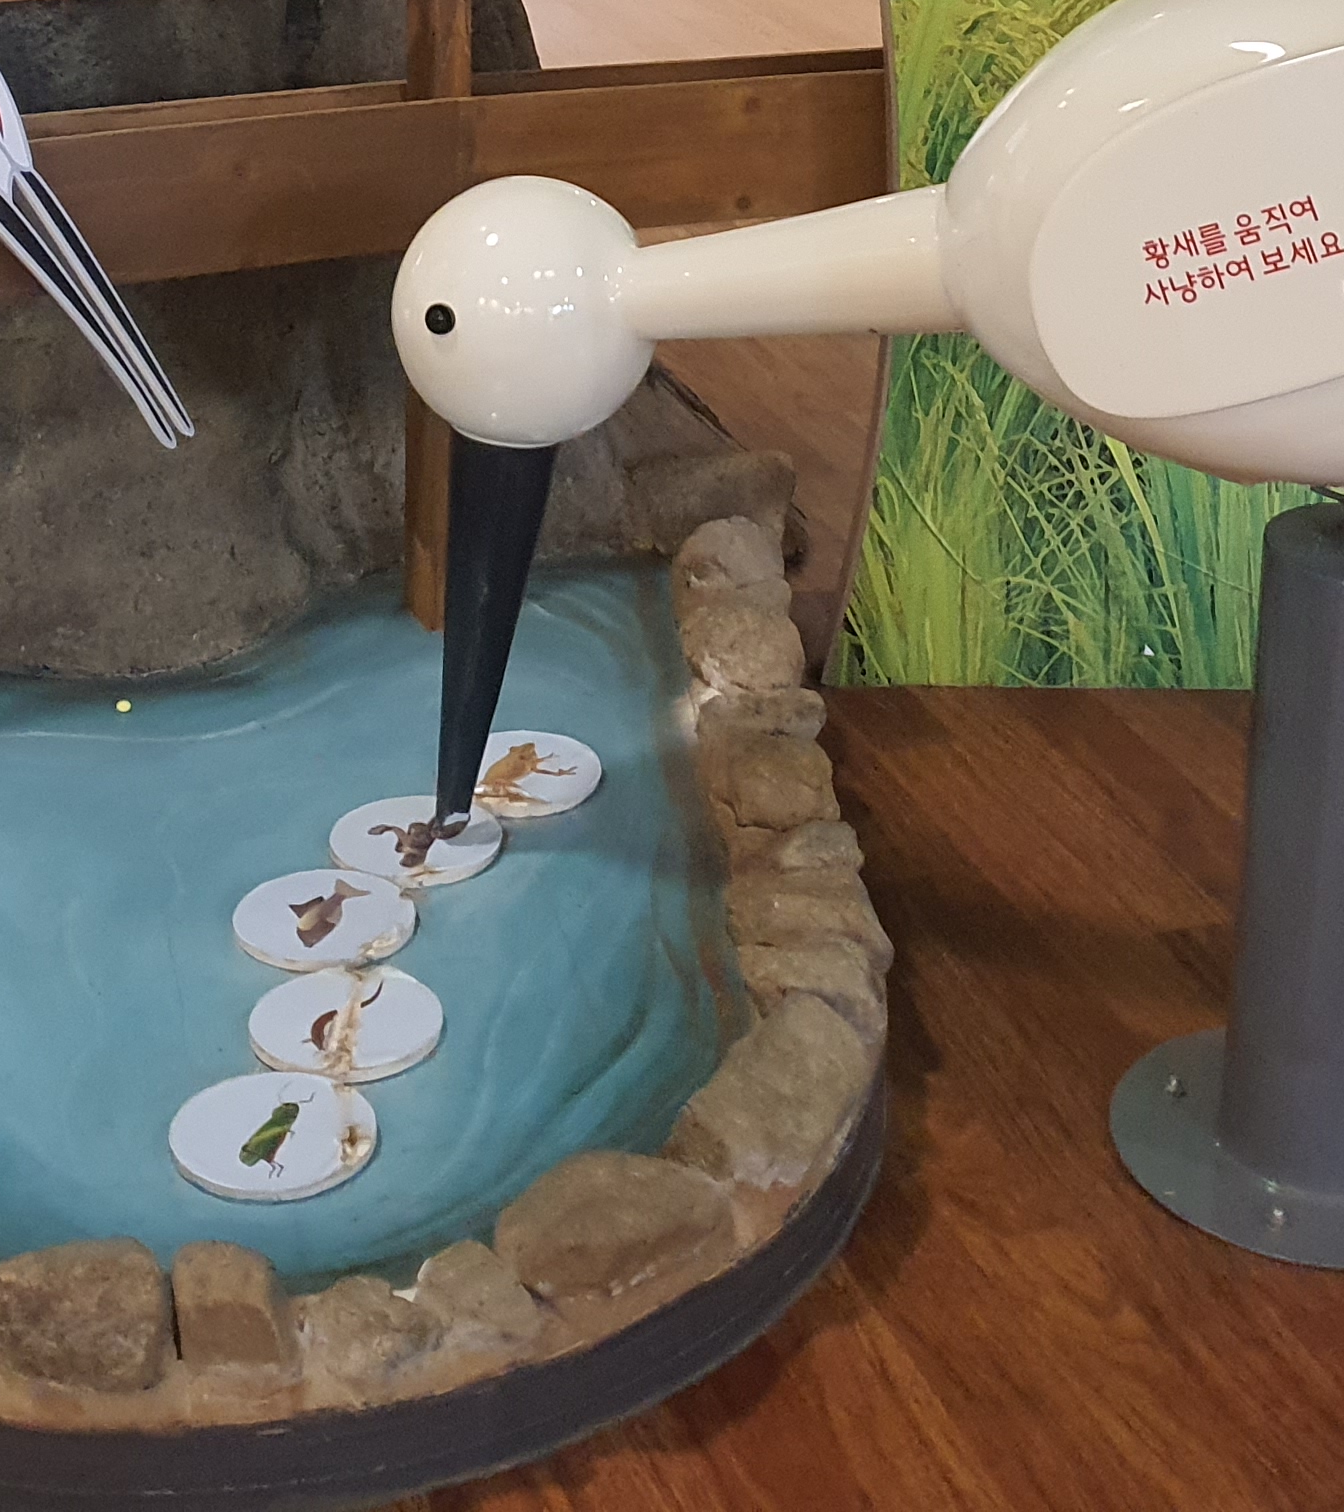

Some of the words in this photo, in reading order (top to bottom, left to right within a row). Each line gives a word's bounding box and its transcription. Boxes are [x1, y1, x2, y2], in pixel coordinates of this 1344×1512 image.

[1142, 222, 1227, 270] 황새를
[1233, 194, 1319, 247] 움직여
[1144, 254, 1255, 306] 사냥하여
